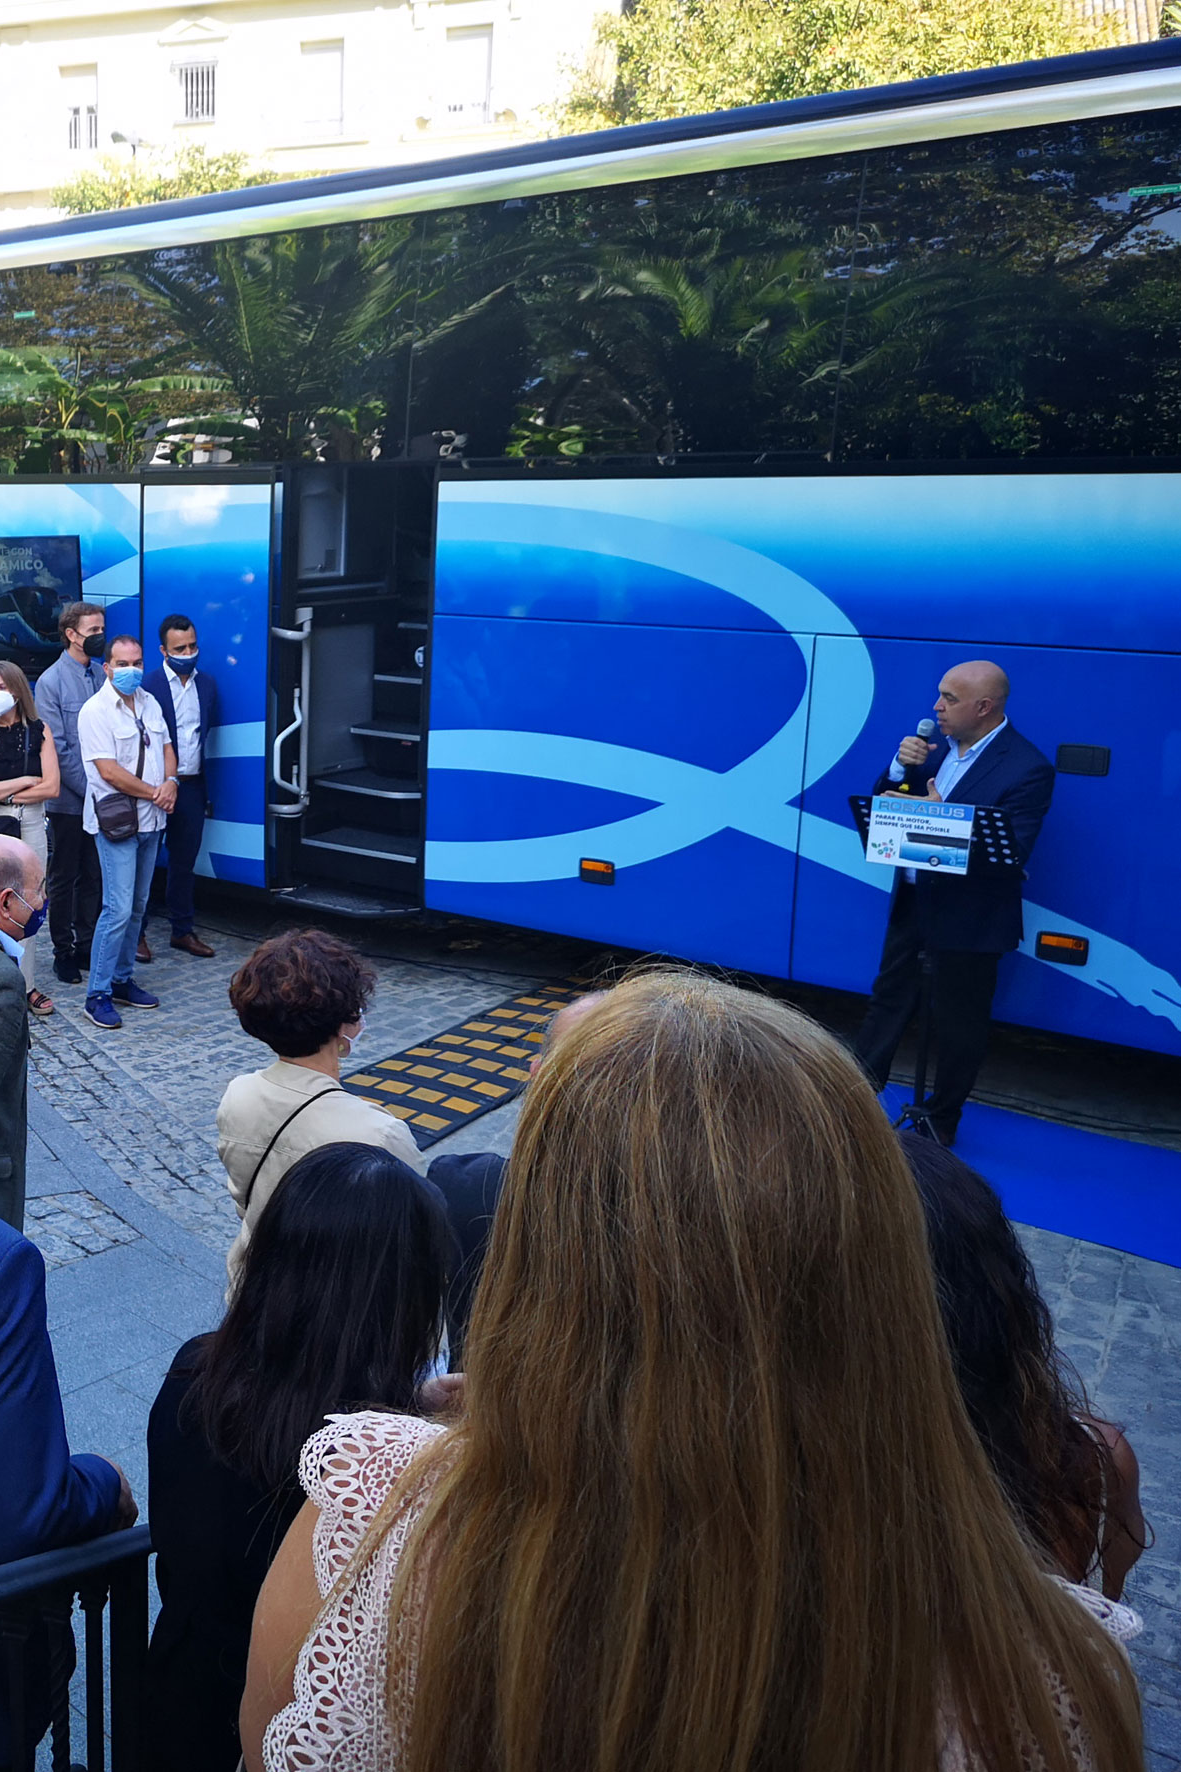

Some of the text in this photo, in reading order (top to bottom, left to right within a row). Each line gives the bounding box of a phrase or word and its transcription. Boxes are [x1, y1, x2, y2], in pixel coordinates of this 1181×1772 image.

[10, 547, 32, 556] CON
[878, 800, 965, 818] ROSABUS
[926, 825, 950, 833] POSIBLE
